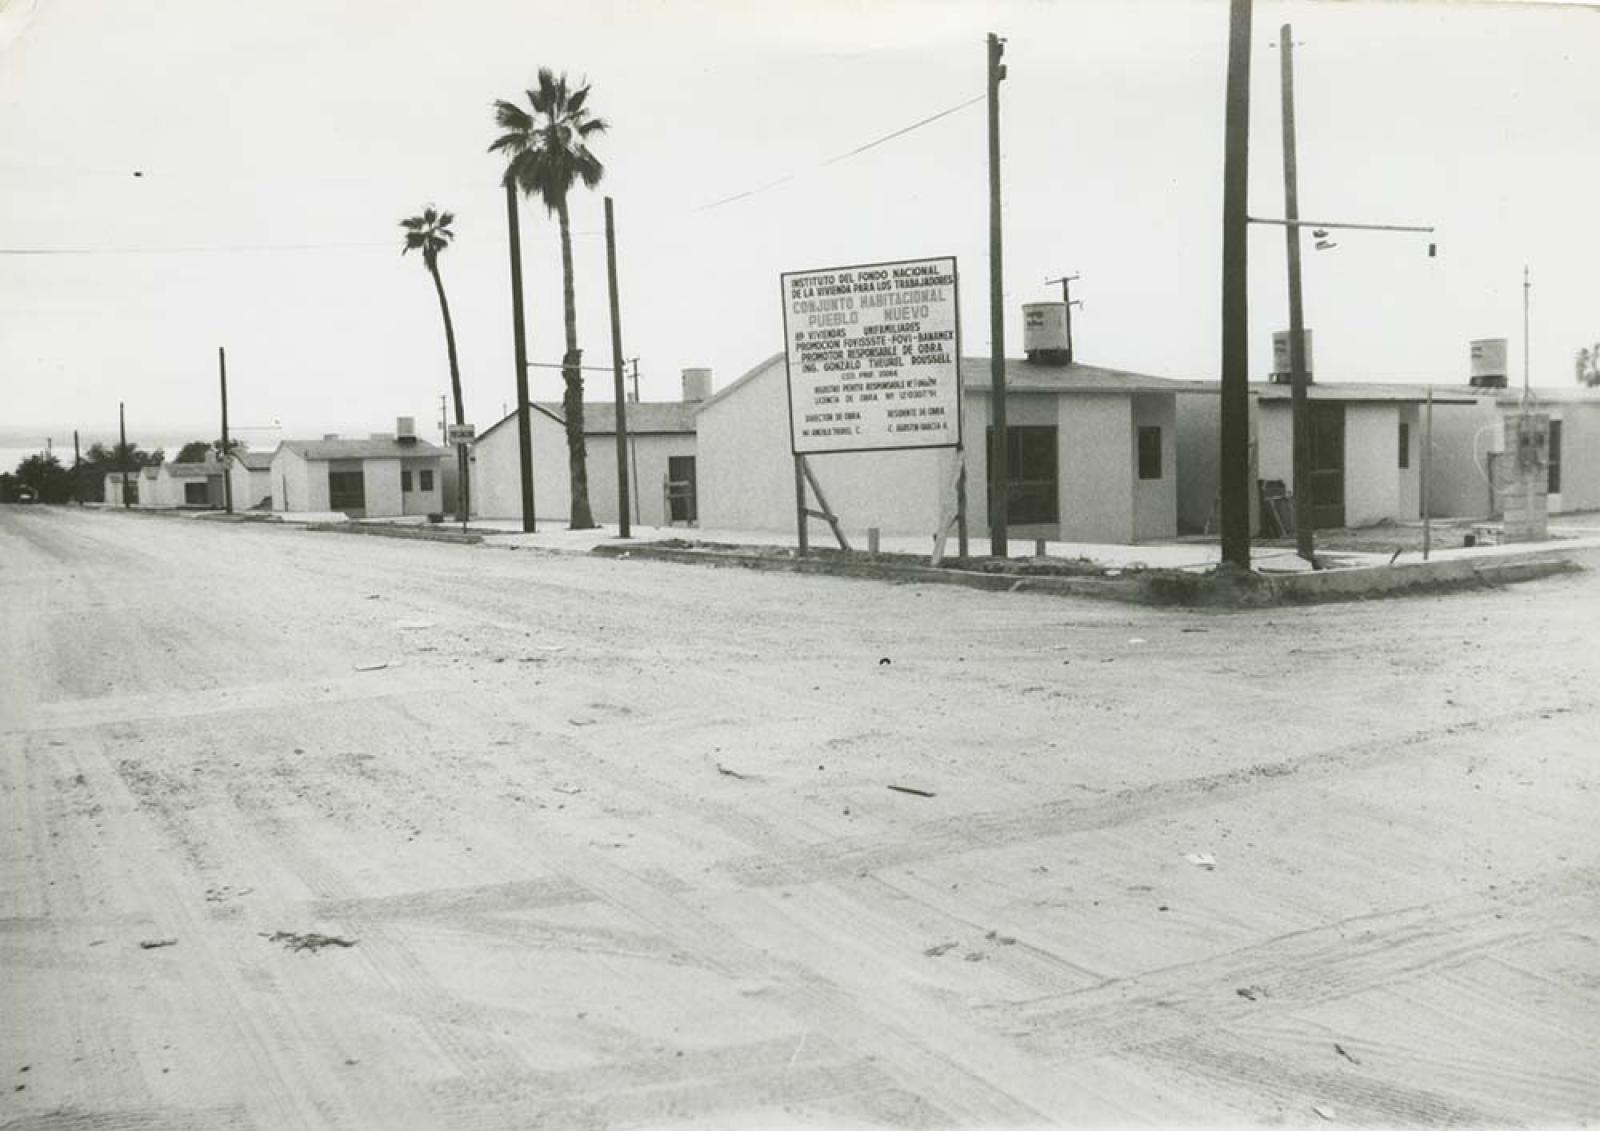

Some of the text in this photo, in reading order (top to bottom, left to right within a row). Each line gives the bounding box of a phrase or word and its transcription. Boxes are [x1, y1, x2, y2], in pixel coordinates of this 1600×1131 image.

[791, 264, 940, 288] INSTITUTO DEL FONDO NACIONAL
[792, 289, 801, 299] DE
[803, 287, 814, 298] LA
[816, 284, 851, 296] VIVIENDA
[853, 281, 875, 293] PARA
[877, 279, 891, 291] LOS
[793, 288, 946, 314] CONJUNTO HABITACIONAL
[808, 304, 929, 327] PUEBLO NUEVO
[808, 328, 847, 339] VIVIENDAS
[863, 321, 920, 336] UNIFAMILIARES
[795, 339, 841, 352] PROMOCION
[802, 342, 943, 361] PROMOTOR RESPONSABLE DE OBRA
[824, 359, 861, 371] GONZALO
